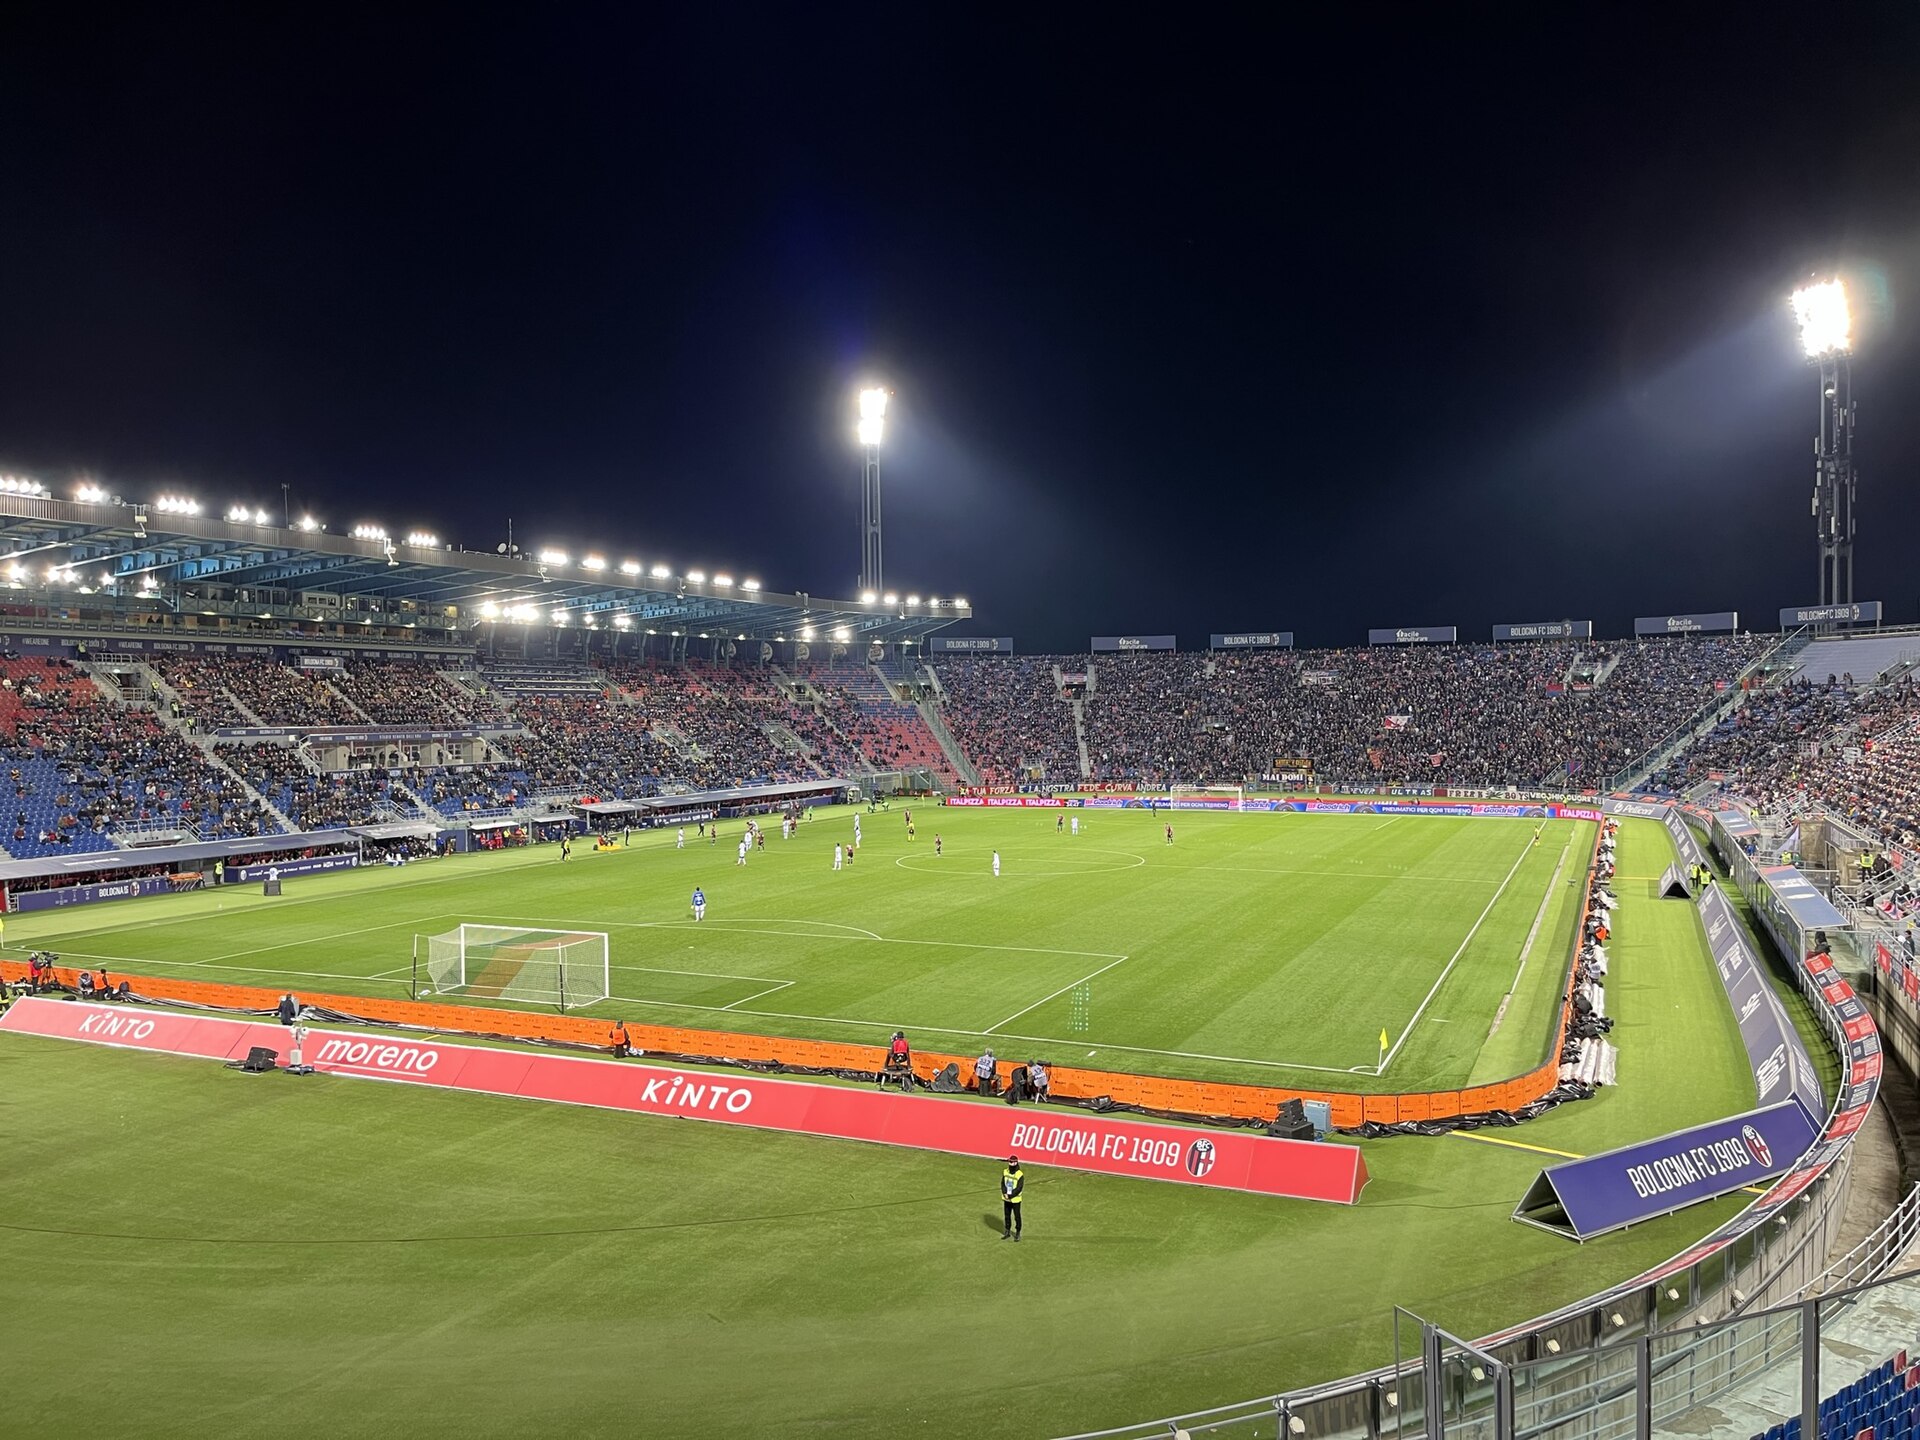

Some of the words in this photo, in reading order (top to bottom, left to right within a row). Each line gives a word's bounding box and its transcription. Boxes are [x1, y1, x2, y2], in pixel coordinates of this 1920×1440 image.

[1798, 610, 1825, 621] BOLOGNA
[1834, 608, 1849, 618] 1909
[1510, 627, 1537, 636] BOLOGNA
[1538, 627, 1546, 635] FC
[1547, 626, 1561, 634] 1909
[946, 641, 969, 649] BOLOGNA
[977, 640, 990, 648] 1909
[1223, 637, 1248, 645] BOLOGNA
[1249, 636, 1256, 644] FC
[1256, 635, 1270, 644] 1909
[1262, 773, 1280, 781] MAI
[972, 786, 987, 795] TUA
[989, 786, 1015, 794] FORZA
[1018, 785, 1027, 793] E
[1041, 784, 1075, 793] NOSTRA
[1077, 784, 1101, 792] FEDE
[1104, 783, 1133, 792] CURVA
[1135, 783, 1167, 793] ANDREA
[1391, 788, 1432, 796] ULTRAS
[1308, 802, 1350, 811] BFGoodrich
[1382, 805, 1416, 813] PNEUMATICI
[1560, 809, 1594, 818] ITALPIZZA
[99, 886, 124, 898] BOLOGNA
[316, 1037, 439, 1072] moreno
[1010, 1123, 1096, 1157] BOLOGNA
[1101, 1134, 1127, 1161] FC
[1127, 1137, 1181, 1167] 1909
[1626, 1152, 1701, 1199] BOLOGNA
[1691, 1147, 1717, 1180] FC
[1707, 1137, 1751, 1173] 1909
